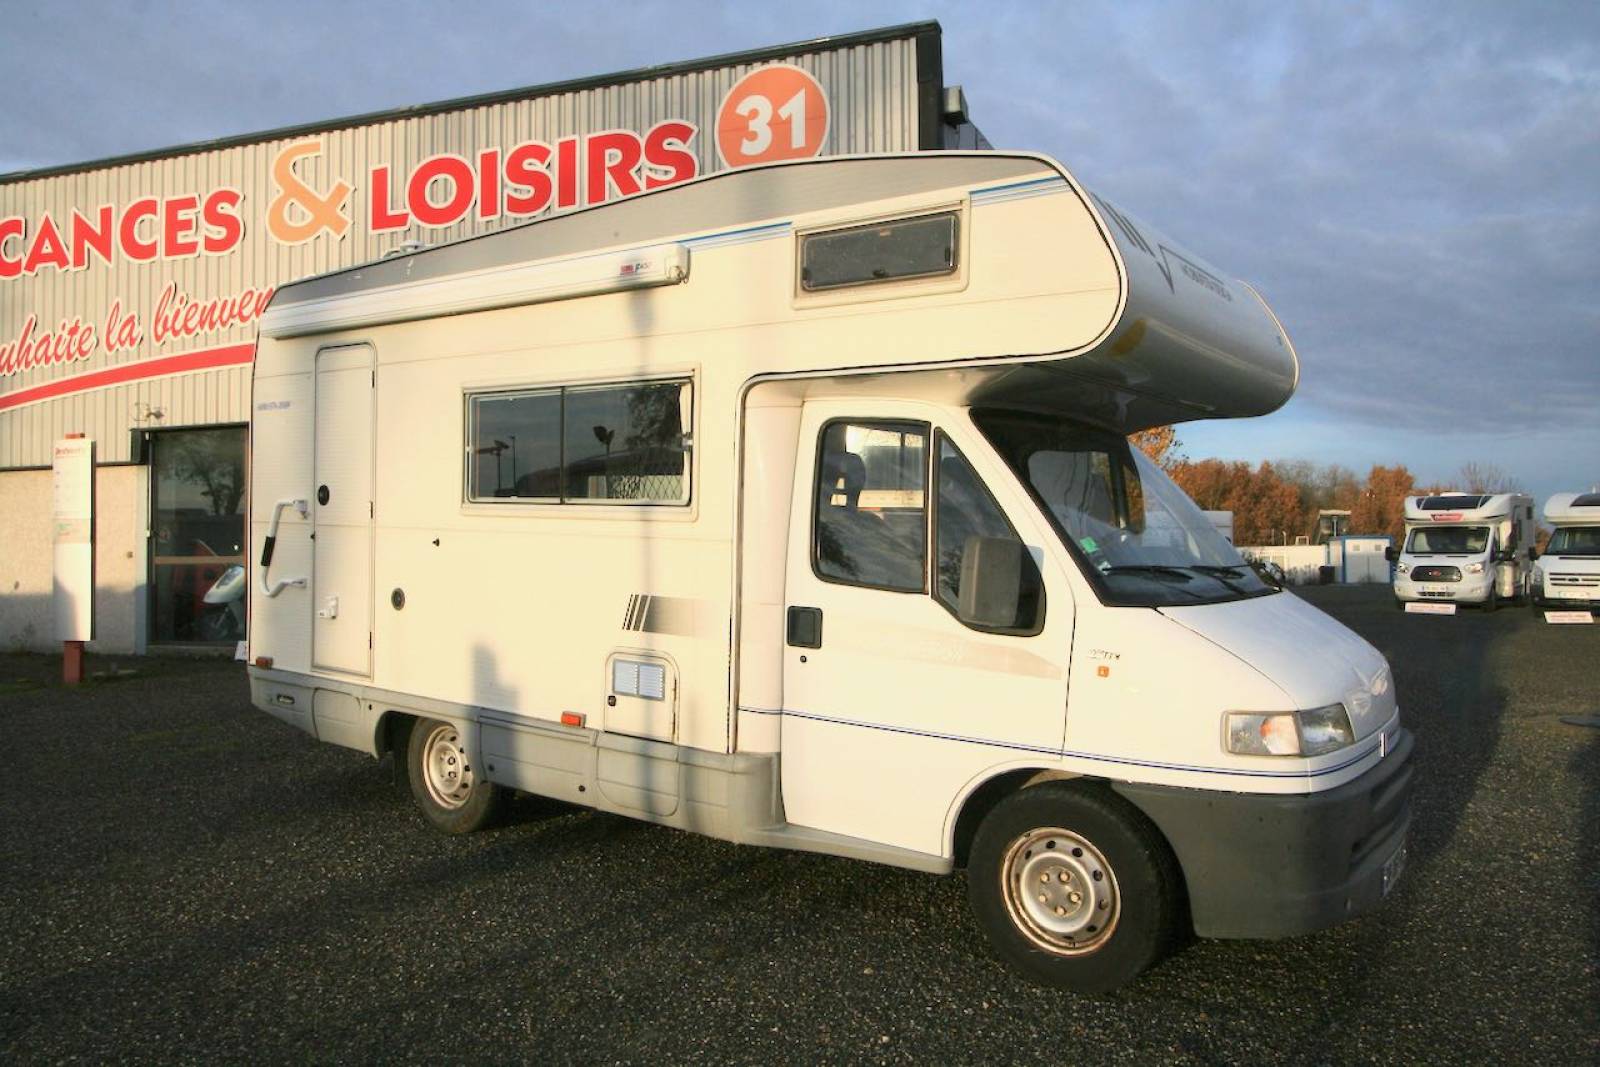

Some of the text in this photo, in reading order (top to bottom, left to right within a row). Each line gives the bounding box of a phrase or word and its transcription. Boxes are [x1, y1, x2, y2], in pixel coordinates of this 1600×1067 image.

[0, 88, 807, 278] CANCES & LOISIRS 31
[105, 299, 141, 352] la
